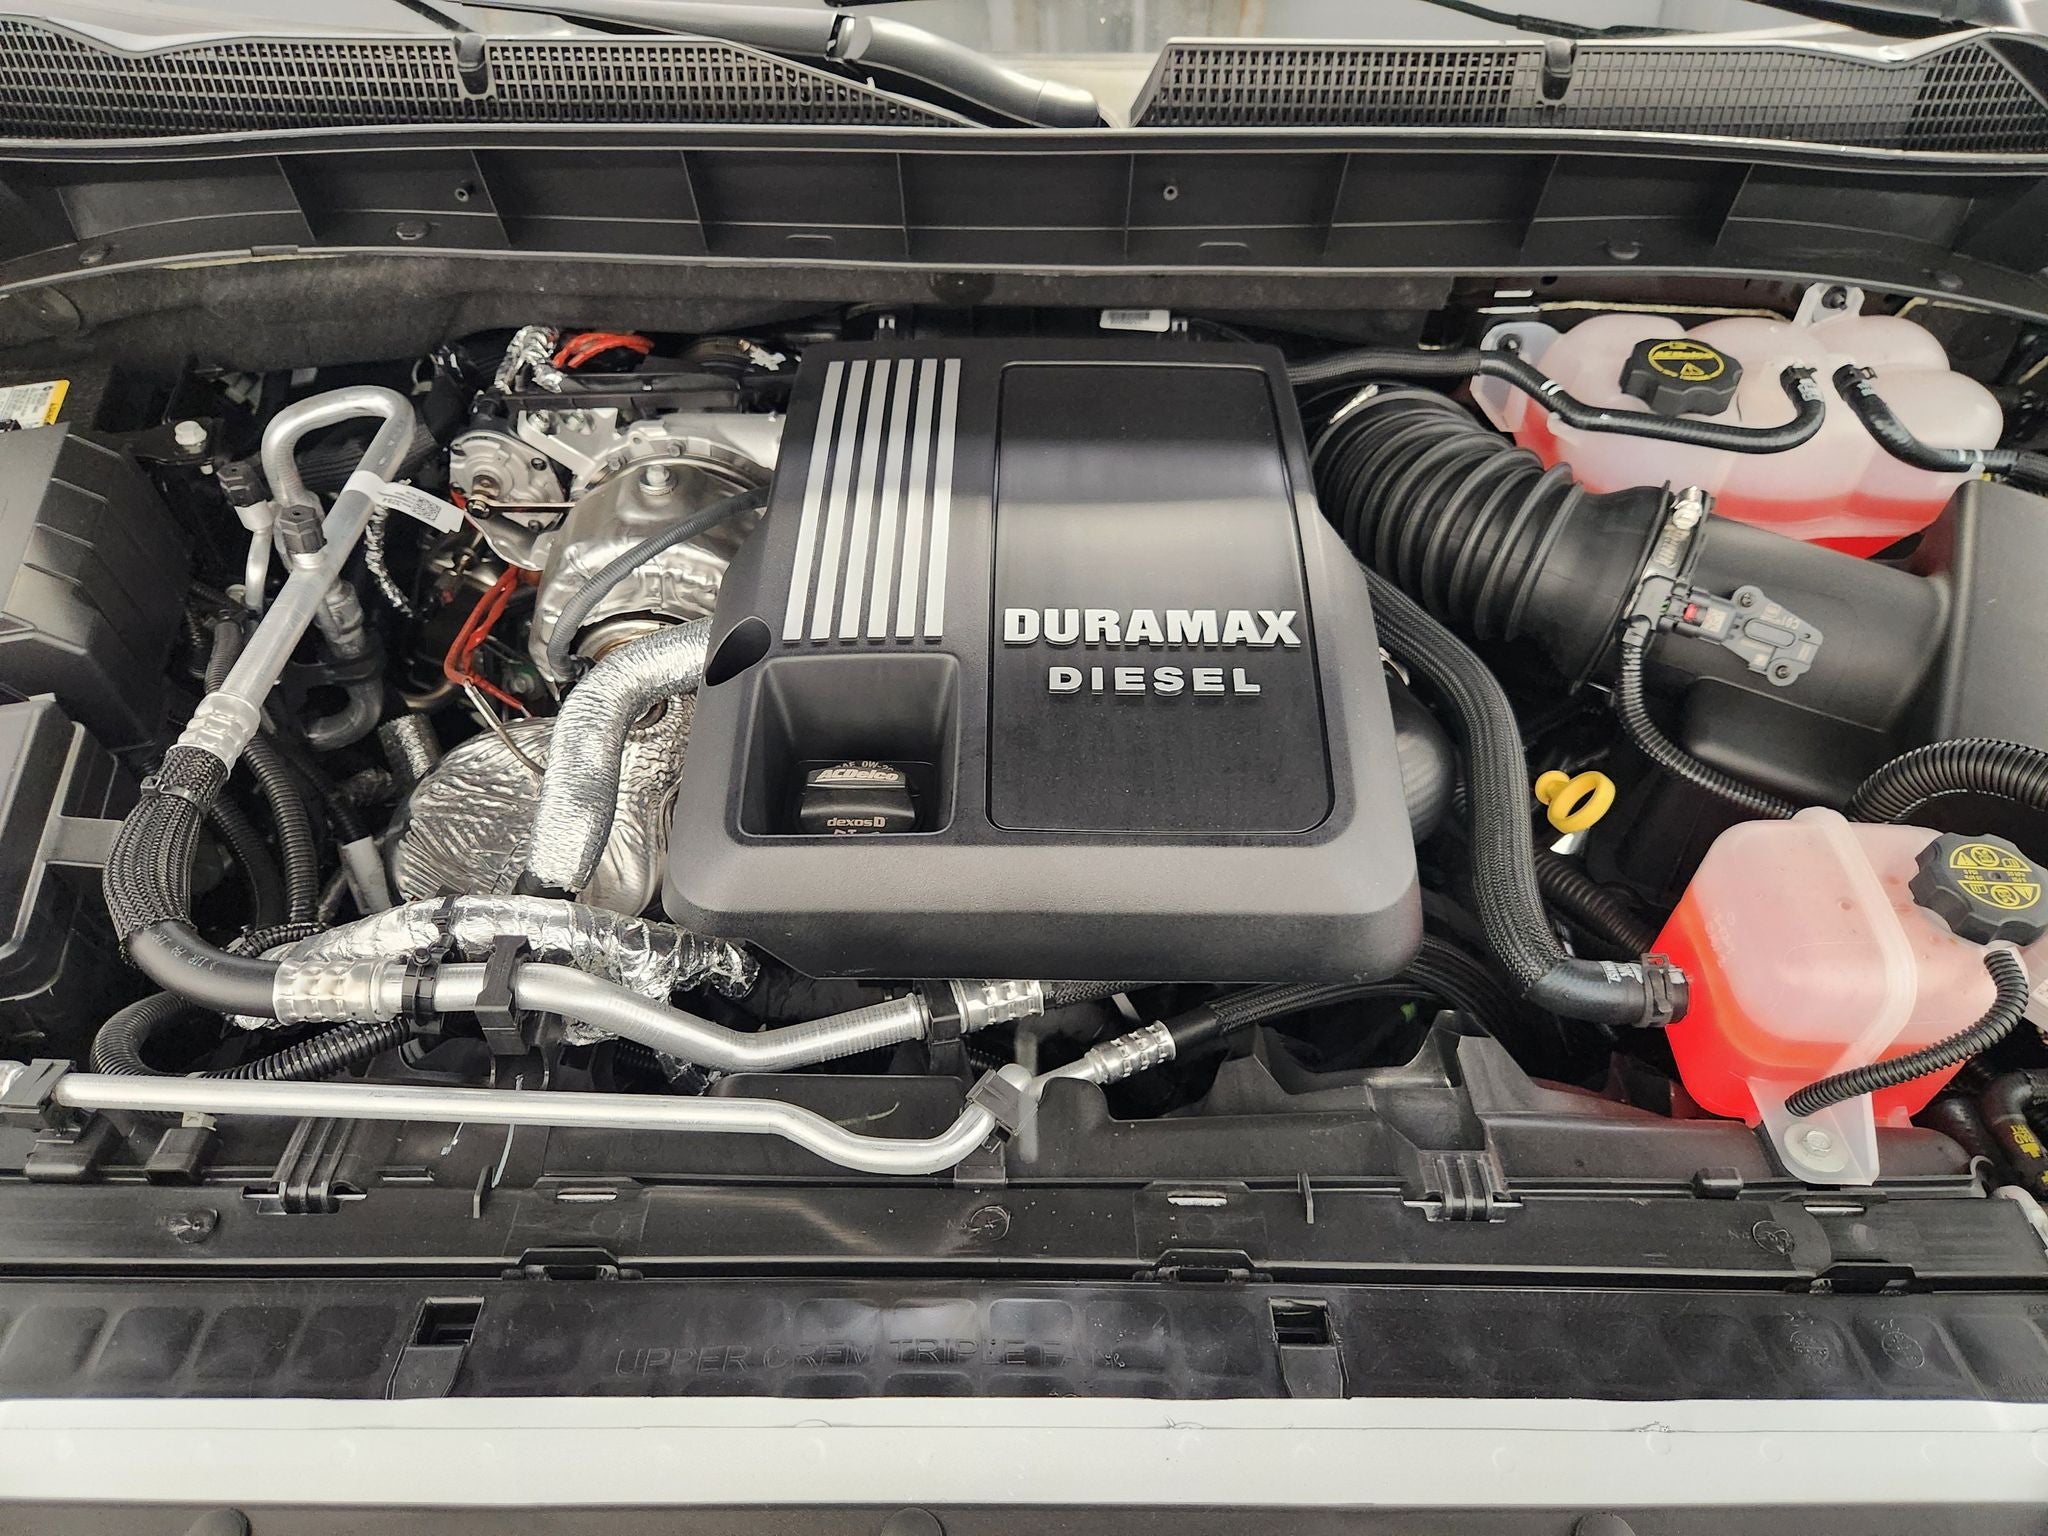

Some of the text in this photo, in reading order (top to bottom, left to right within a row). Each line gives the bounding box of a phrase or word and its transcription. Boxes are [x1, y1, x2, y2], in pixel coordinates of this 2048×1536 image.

[1003, 608, 1301, 646] DURAMAX
[1049, 666, 1261, 694] DIESEL
[816, 769, 899, 781] ACDelco
[615, 1343, 752, 1376] UPPER
[889, 1337, 1026, 1366] TRIPLE
